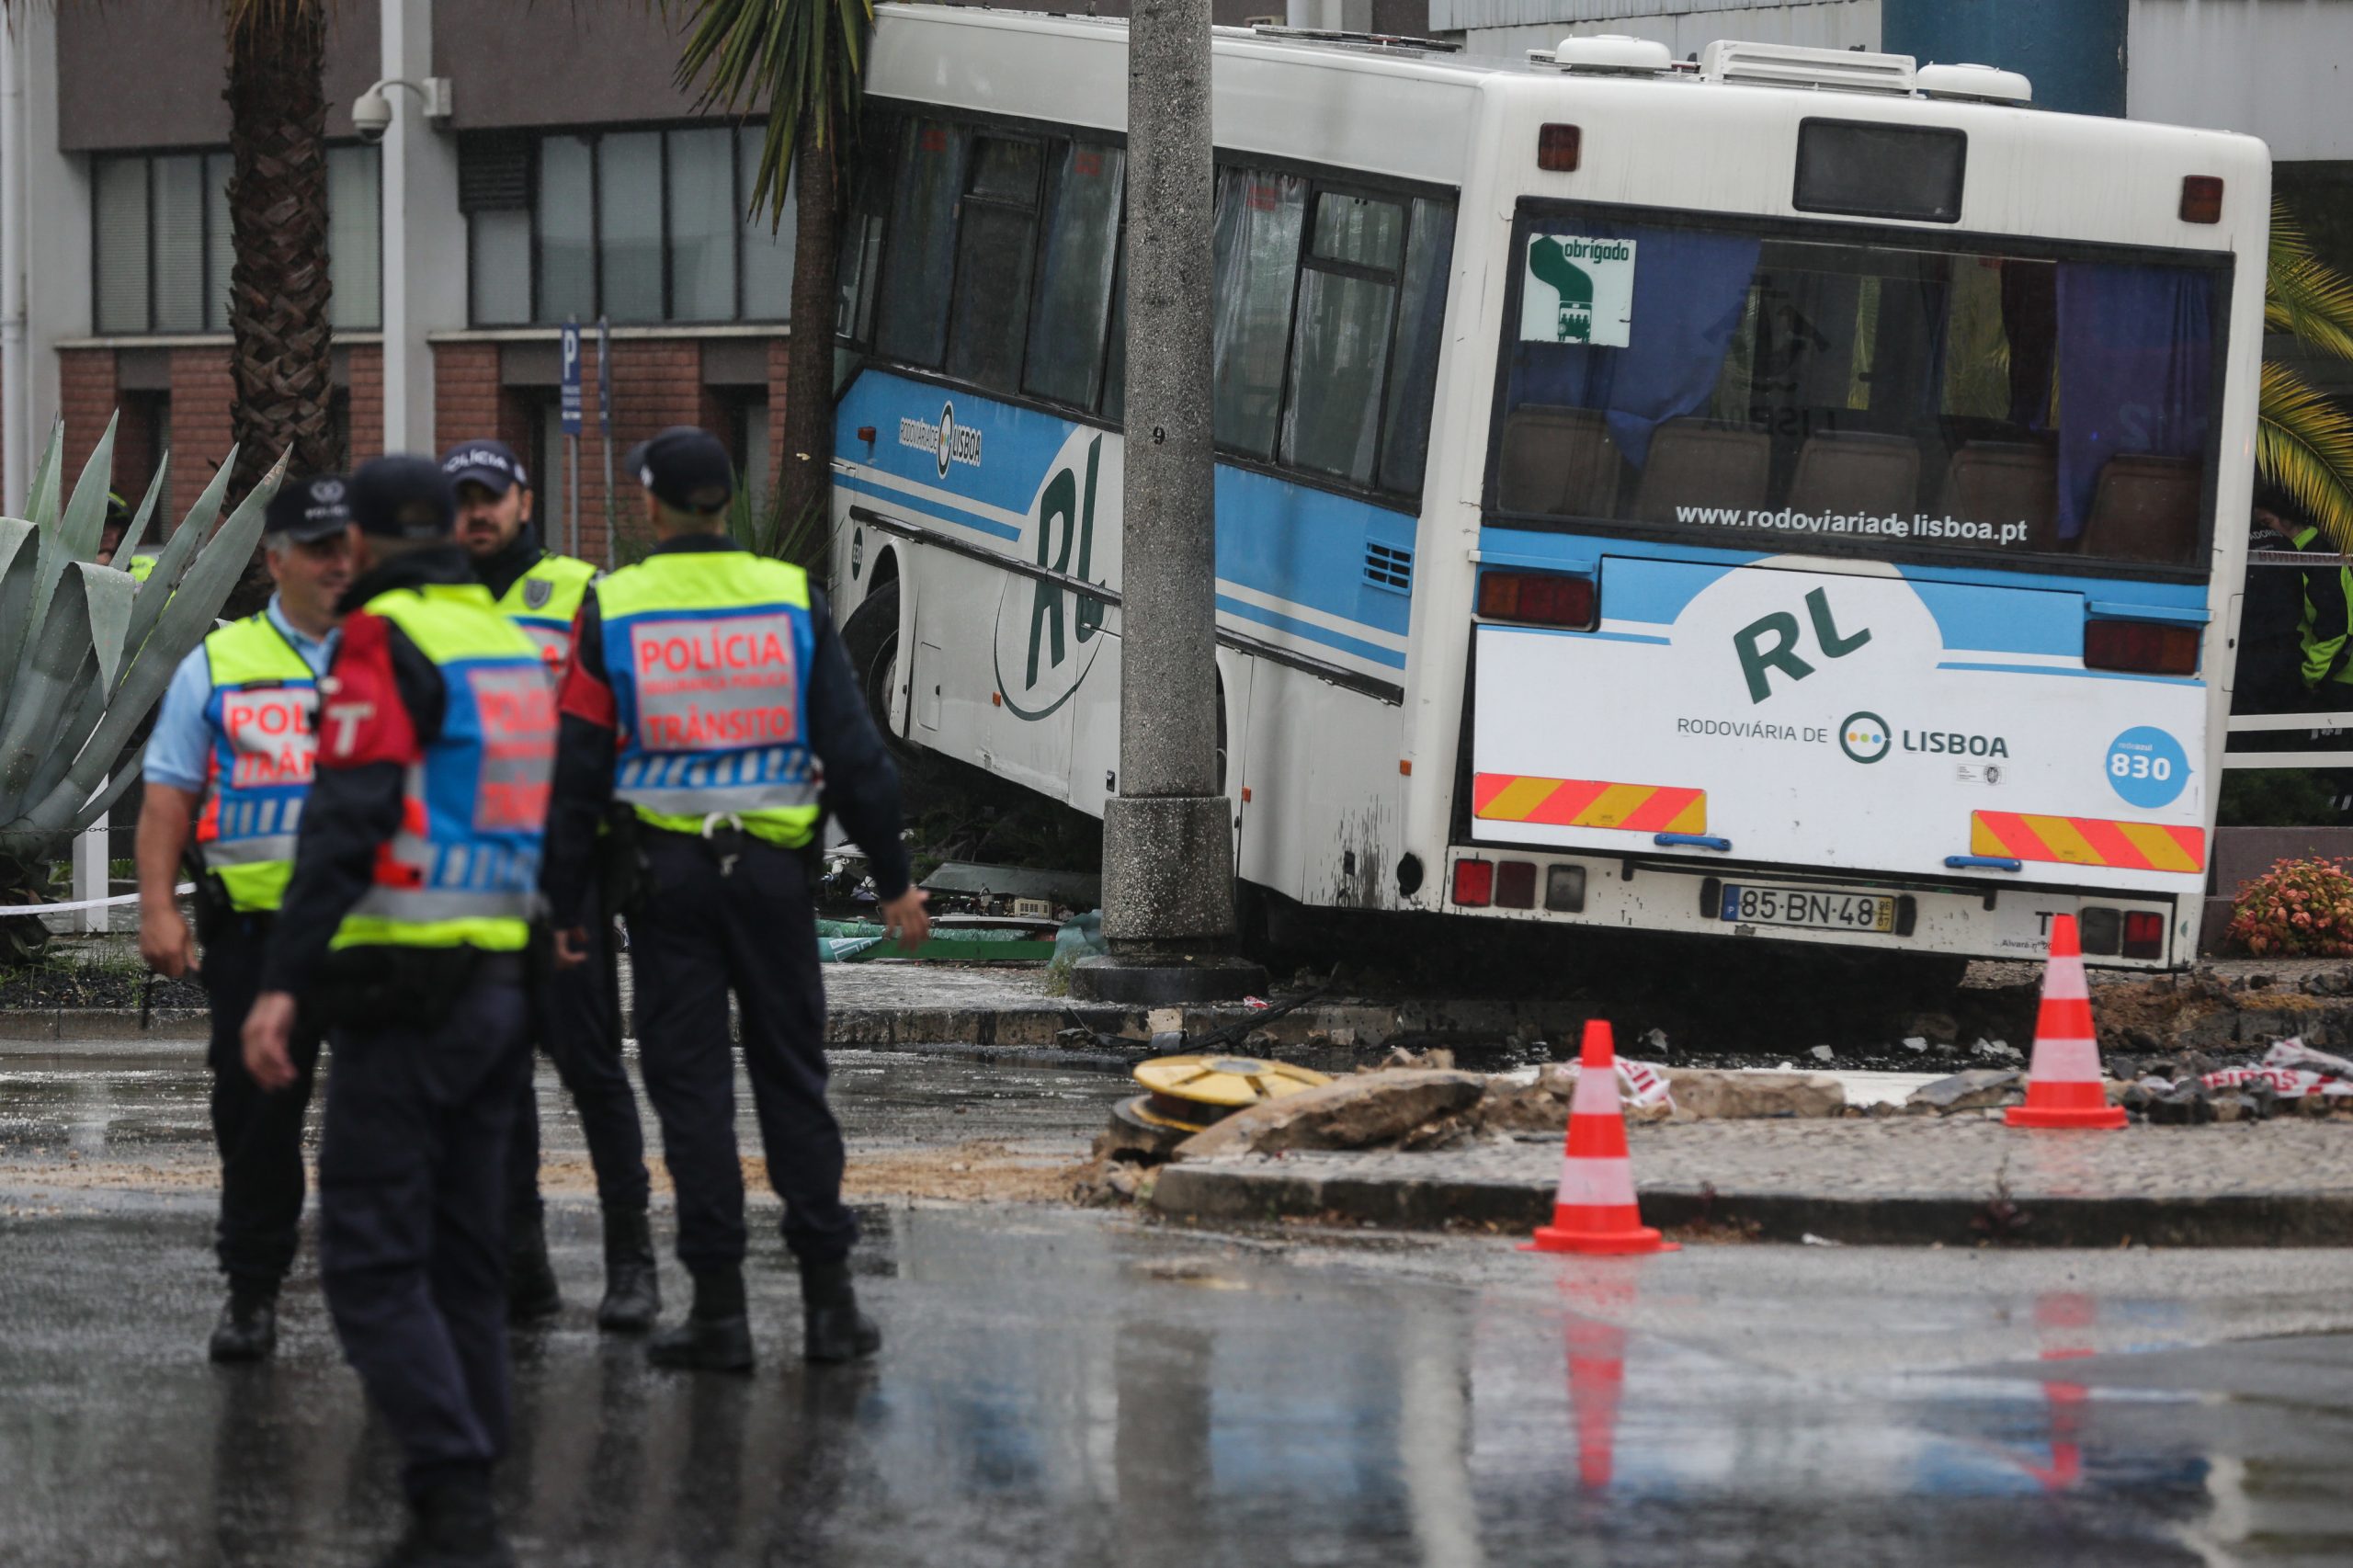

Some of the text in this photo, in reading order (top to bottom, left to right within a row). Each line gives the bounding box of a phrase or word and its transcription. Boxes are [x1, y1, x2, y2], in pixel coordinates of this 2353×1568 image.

[1564, 240, 1629, 264] obrigado
[563, 329, 577, 380] P
[952, 427, 981, 463] LISBOA
[1153, 426, 1165, 445] 9
[1026, 433, 1106, 691] RL
[641, 627, 789, 675] POLÍCIA
[1733, 586, 1872, 704] RL
[327, 703, 375, 755] T
[646, 703, 791, 745] TRÂNSITO
[1677, 718, 2009, 758] RODOVIÁRIA DE LISBOA
[2111, 753, 2171, 781] 830
